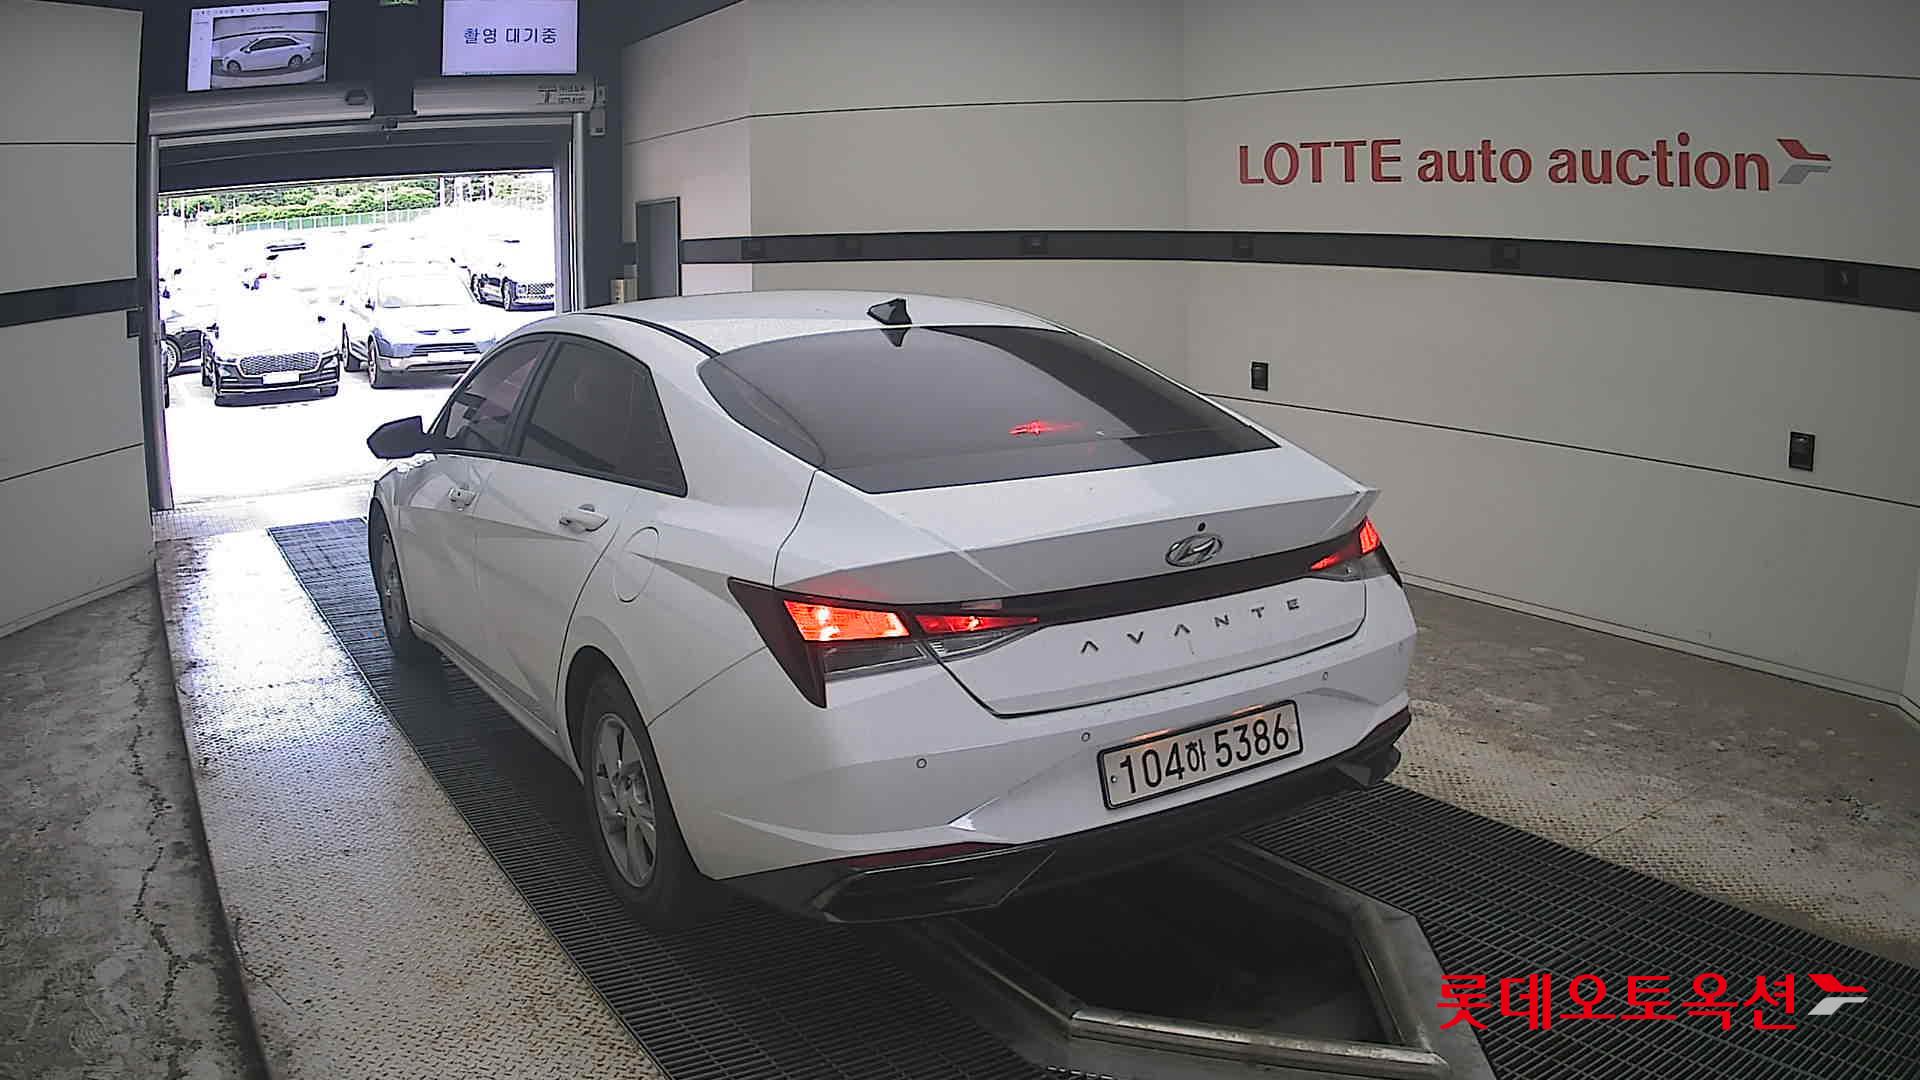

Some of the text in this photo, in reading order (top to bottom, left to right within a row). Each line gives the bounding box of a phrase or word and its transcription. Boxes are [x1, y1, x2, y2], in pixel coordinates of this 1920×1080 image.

[463, 27, 559, 45] 촬영 대기중
[1238, 131, 1771, 191] LOTTE auto auction
[1079, 597, 1302, 655] AVANTE
[1118, 713, 1291, 795] 104하 5386
